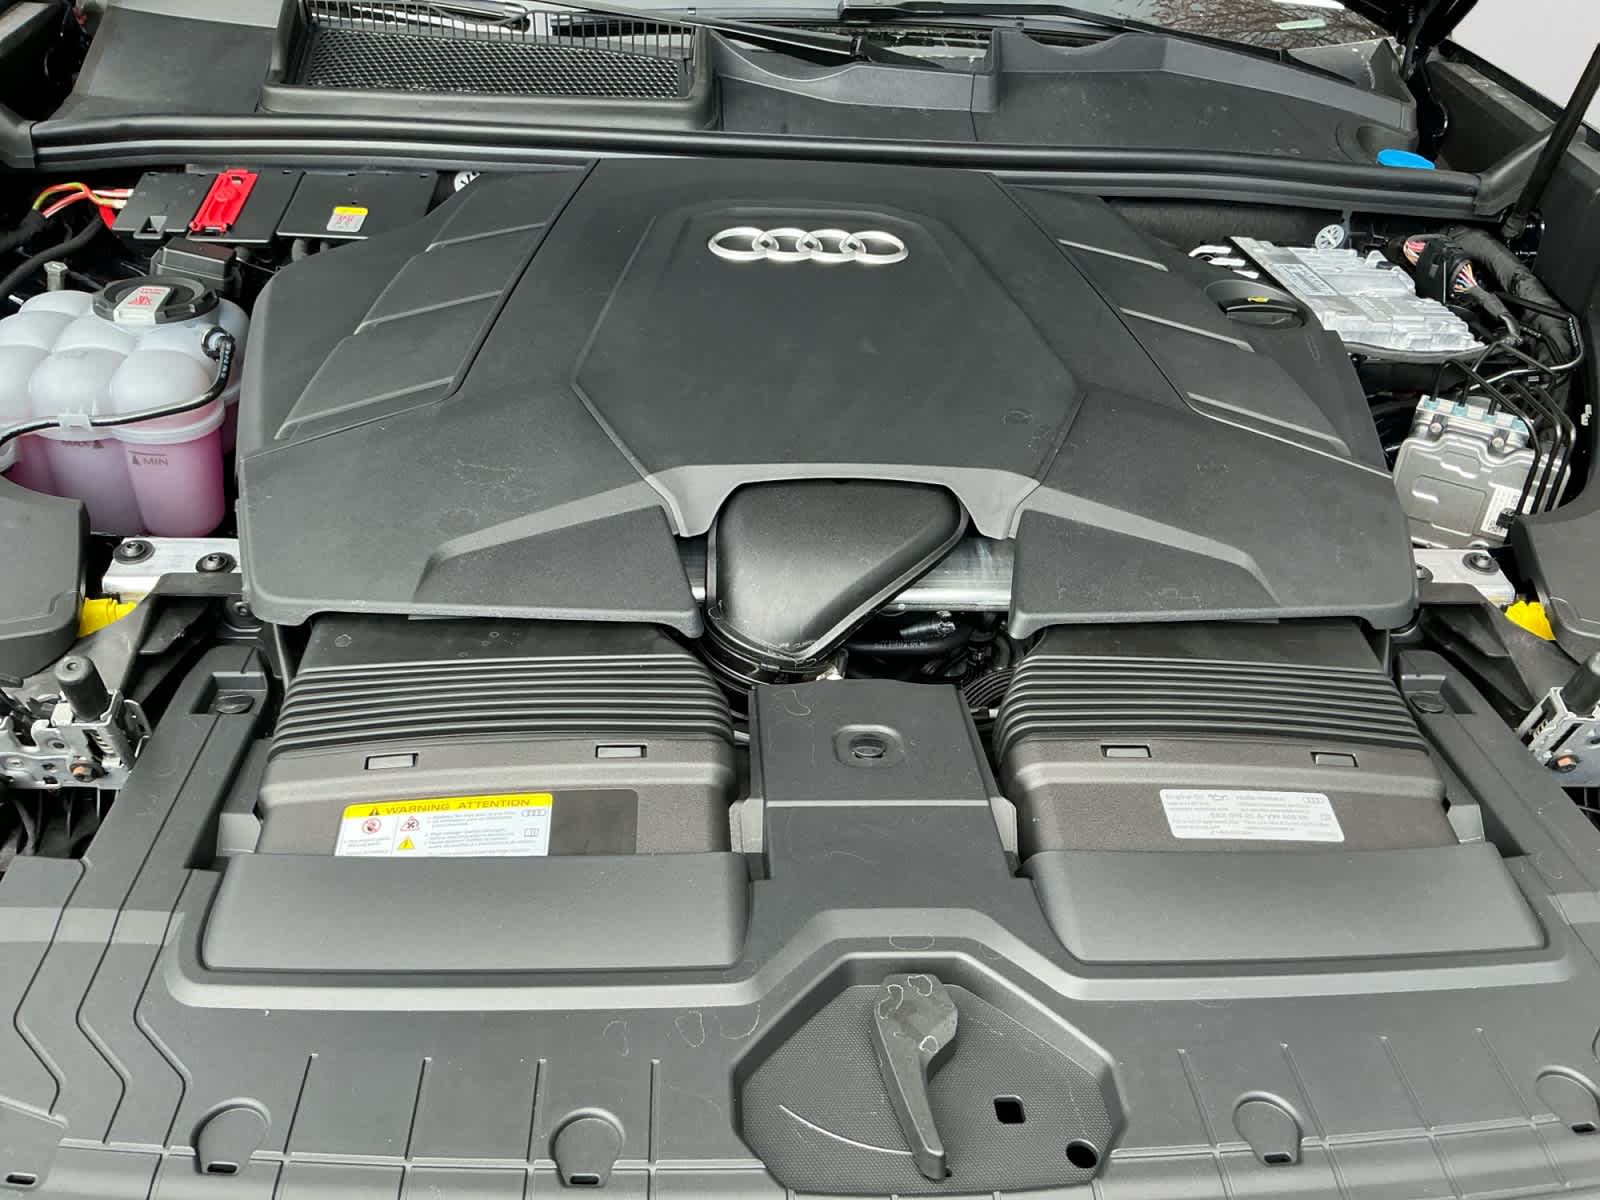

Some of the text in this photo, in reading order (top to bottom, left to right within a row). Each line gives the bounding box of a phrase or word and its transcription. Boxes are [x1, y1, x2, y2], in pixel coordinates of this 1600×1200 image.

[143, 457, 169, 466] MIN
[386, 799, 531, 815] WARNING ATTENTION
